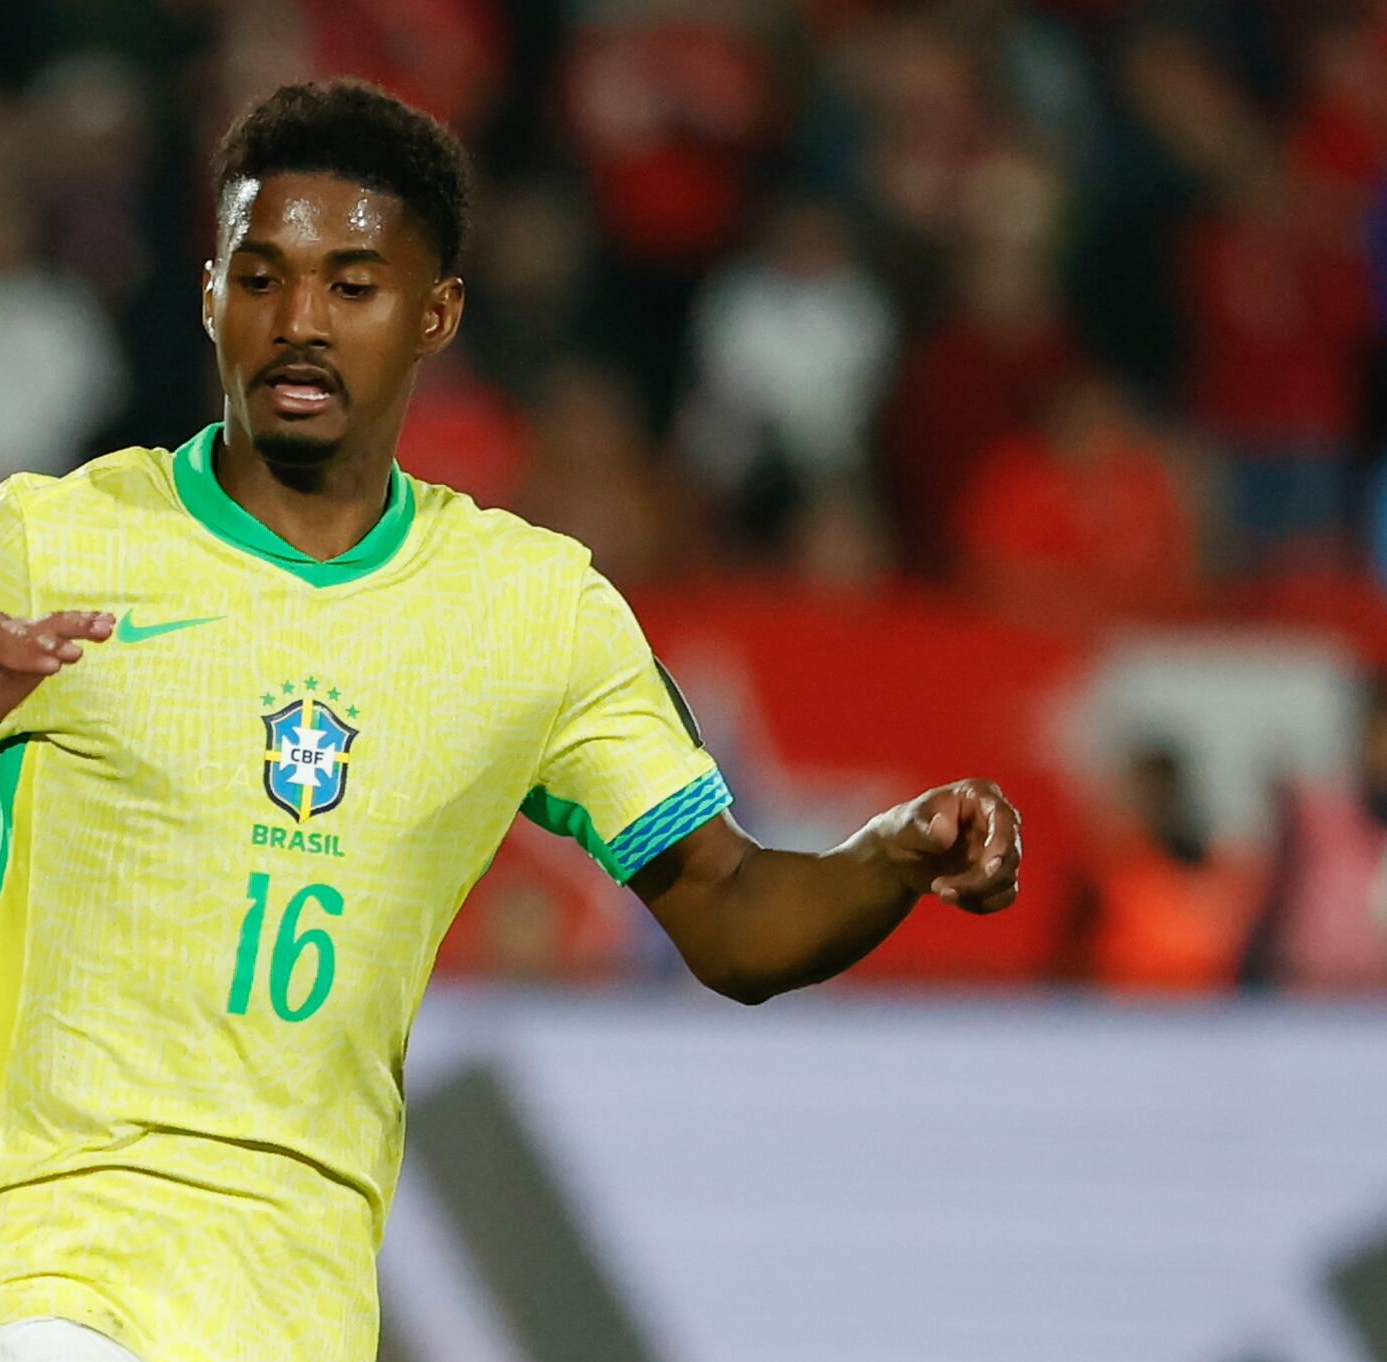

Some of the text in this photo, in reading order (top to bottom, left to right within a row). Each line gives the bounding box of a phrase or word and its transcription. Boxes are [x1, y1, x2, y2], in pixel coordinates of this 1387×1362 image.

[289, 747, 325, 766] CBF
[250, 823, 346, 858] BRASIL
[226, 870, 345, 1023] 16
